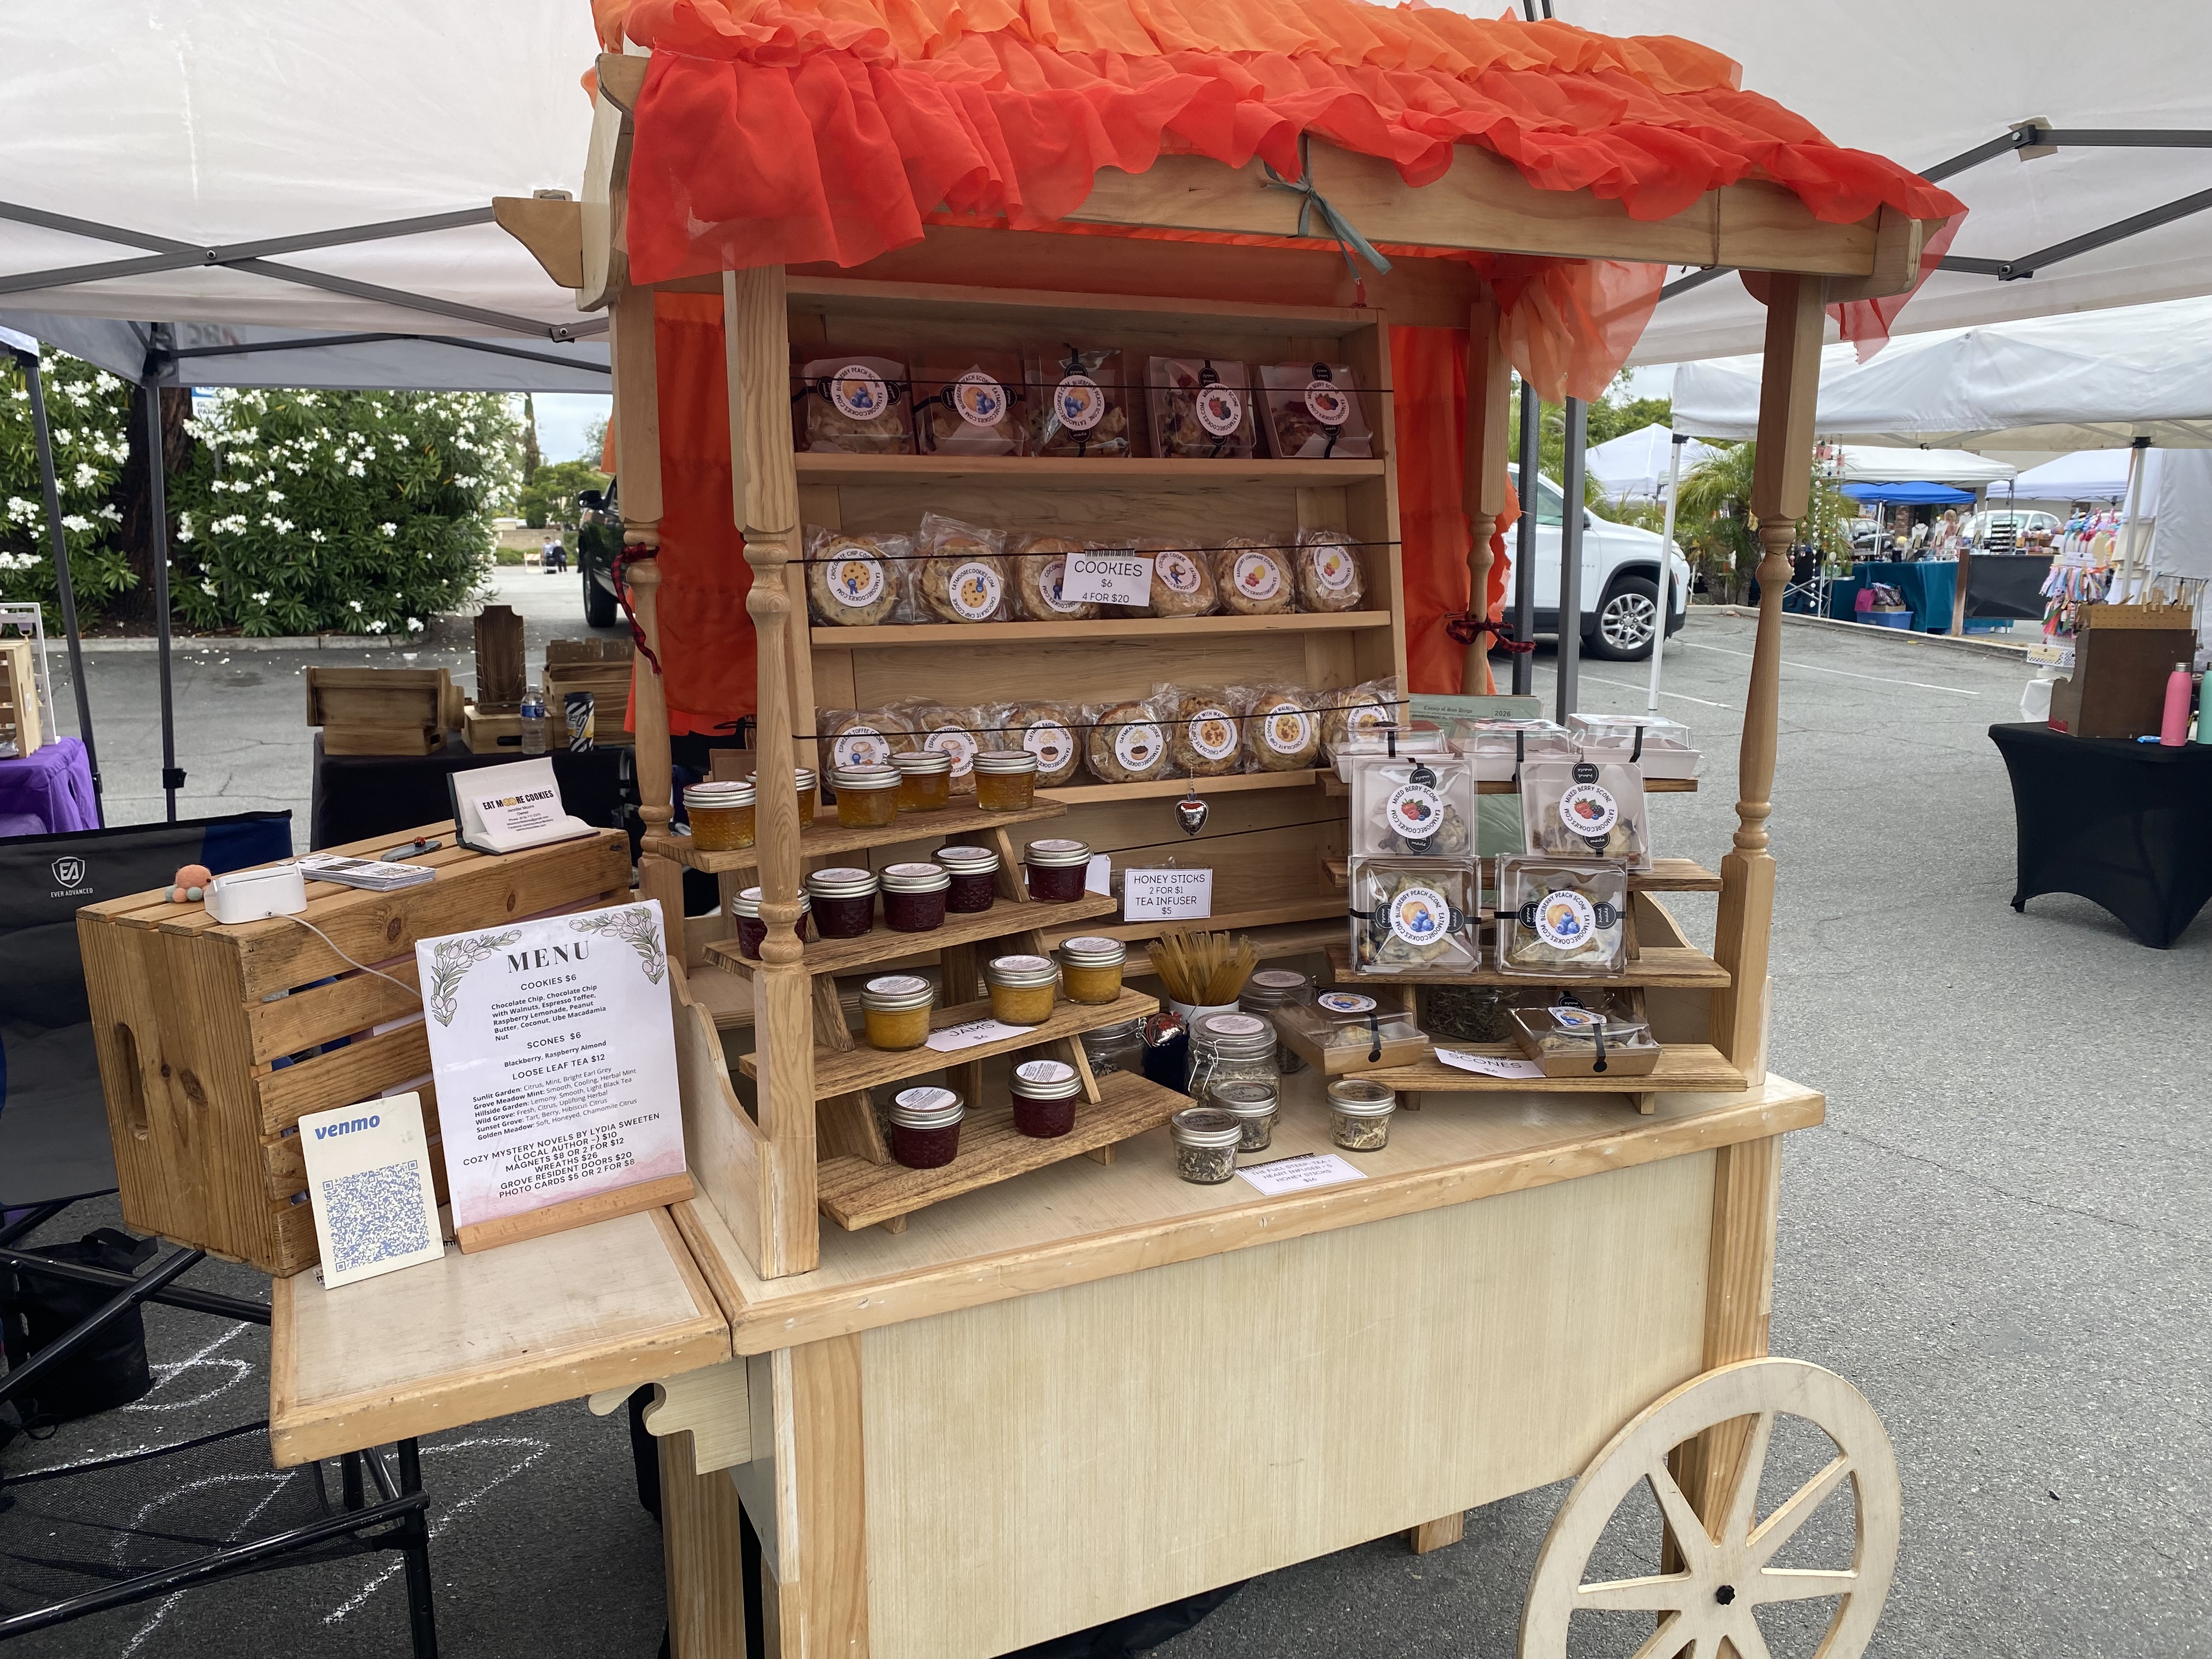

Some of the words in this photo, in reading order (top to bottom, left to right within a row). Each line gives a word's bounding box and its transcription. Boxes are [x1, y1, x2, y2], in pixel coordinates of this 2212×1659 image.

[1074, 560, 1143, 577] COOKIES
[1101, 579, 1113, 588] $6
[977, 596, 996, 618] CHOCOLATE
[1090, 592, 1109, 601] FOR
[1111, 594, 1129, 603] $20
[482, 801, 495, 810] EAT
[525, 789, 554, 802] COOKIES
[1392, 790, 1404, 804] MIXED
[1423, 788, 1438, 803] SCONE
[1565, 789, 1577, 803] MIXED
[1596, 788, 1612, 803] SCONE
[59, 861, 79, 881] EA
[1134, 875, 1169, 884] HONEY
[1171, 874, 1205, 883] STICKS
[65, 888, 93, 896] ADVANCED
[1135, 897, 1153, 906] TEA
[1156, 896, 1197, 905] INFUSER
[1395, 893, 1409, 918] BLUEBERRY
[1428, 894, 1442, 909] SCONE
[1540, 895, 1554, 921] BLUEBERRY
[1573, 895, 1587, 911] SCONE
[506, 940, 589, 974] MENU
[520, 977, 563, 991] COOKIES
[565, 974, 577, 983] $6
[491, 999, 527, 1010] Chocolate
[546, 988, 581, 999] Chocolate
[582, 984, 597, 992] Chip
[492, 1009, 509, 1018] with
[509, 1005, 540, 1015] Walnuts,
[541, 998, 572, 1008] Espresso
[572, 993, 596, 1002] Toffee,
[493, 1014, 529, 1026] Raspberry
[530, 1006, 568, 1019] Lemonade,
[569, 1001, 594, 1011] Peanut
[494, 1025, 520, 1034] Butter,
[520, 1018, 551, 1028] Coconut,
[567, 1006, 606, 1019] Macadamia
[495, 1034, 509, 1042] Nut
[527, 1035, 565, 1049] SCONES
[569, 1031, 582, 1041] $6
[950, 1023, 995, 1036] JAMS
[504, 1055, 544, 1068] Blackberry,
[545, 1047, 579, 1059] Raspberry
[580, 1040, 607, 1051] Almond
[512, 1066, 544, 1080] LOOSE
[546, 1062, 569, 1073] LEAF
[571, 1057, 589, 1067] TEA
[591, 1053, 606, 1063] $12
[1449, 1053, 1522, 1068] SCONES
[472, 1093, 494, 1103] Sunlit
[563, 1073, 583, 1082] Bright
[583, 1069, 596, 1078] Earl
[473, 1101, 495, 1110] Grove
[496, 1094, 526, 1105] Meadow
[600, 1071, 622, 1081] Herbal
[475, 1107, 501, 1118] Hillside
[586, 1084, 602, 1092] Light
[603, 1080, 620, 1088] Black
[475, 1116, 492, 1126] Wild
[559, 1096, 586, 1107] Uplifting
[587, 1089, 608, 1100] Herbal
[315, 1115, 380, 1140] venmo
[476, 1123, 501, 1133] Sunset
[562, 1103, 588, 1113] Hibiscus
[589, 1098, 608, 1107] Citrus
[477, 1131, 503, 1141] Golden
[583, 1103, 618, 1116] Chamomile
[619, 1098, 637, 1107] Citrus
[463, 1153, 489, 1166] COZY
[492, 1142, 534, 1159] MYSTERY
[537, 1133, 574, 1148] NOVELS
[576, 1130, 588, 1139] BY
[590, 1124, 617, 1136] LYDIA
[618, 1112, 660, 1128] SWEETEN
[514, 1148, 549, 1163] (LOCAL
[551, 1138, 589, 1153] AUTHOR
[602, 1131, 617, 1141] $10
[505, 1155, 551, 1172] MAGNETS
[553, 1152, 565, 1161] $8
[567, 1148, 580, 1157] OR
[590, 1141, 608, 1152] FOR
[610, 1137, 625, 1147] $12
[534, 1156, 579, 1173] WREATHS
[581, 1152, 598, 1162] $26
[499, 1184, 532, 1199] PHOTO
[534, 1176, 566, 1189] CARDS
[568, 1172, 579, 1181] $5
[582, 1169, 594, 1177] OR
[604, 1161, 622, 1172] FOR
[624, 1158, 635, 1167] $8
[500, 1176, 533, 1190] GROVE
[535, 1164, 579, 1181] RESIDENT
[581, 1156, 613, 1170] DOORS
[615, 1151, 632, 1161] $20
[1263, 1171, 1287, 1180] HEART
[1276, 1174, 1302, 1182] HONEY
